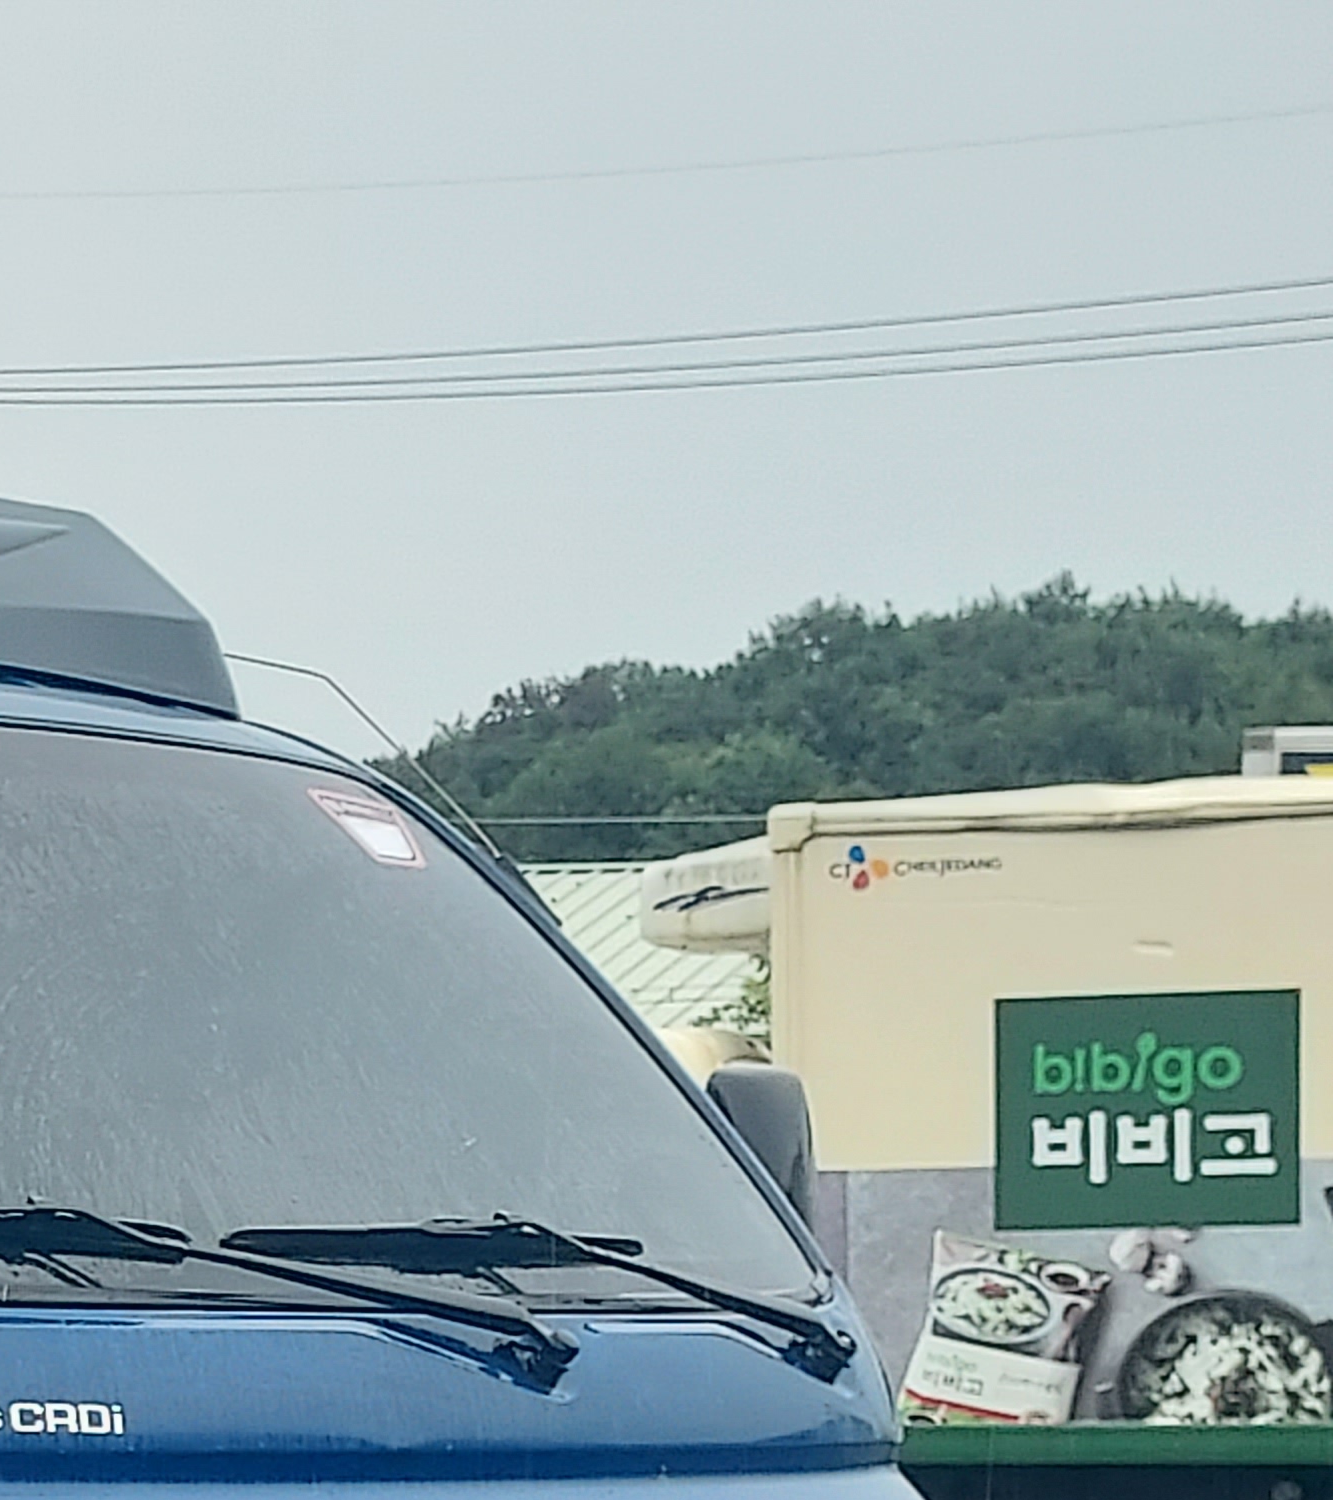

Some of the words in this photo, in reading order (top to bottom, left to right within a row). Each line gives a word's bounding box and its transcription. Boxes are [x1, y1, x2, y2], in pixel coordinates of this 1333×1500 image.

[1034, 1031, 1244, 1105] bibigo
[1032, 1107, 1278, 1185] 비비고
[9, 1402, 124, 1435] CRDi
